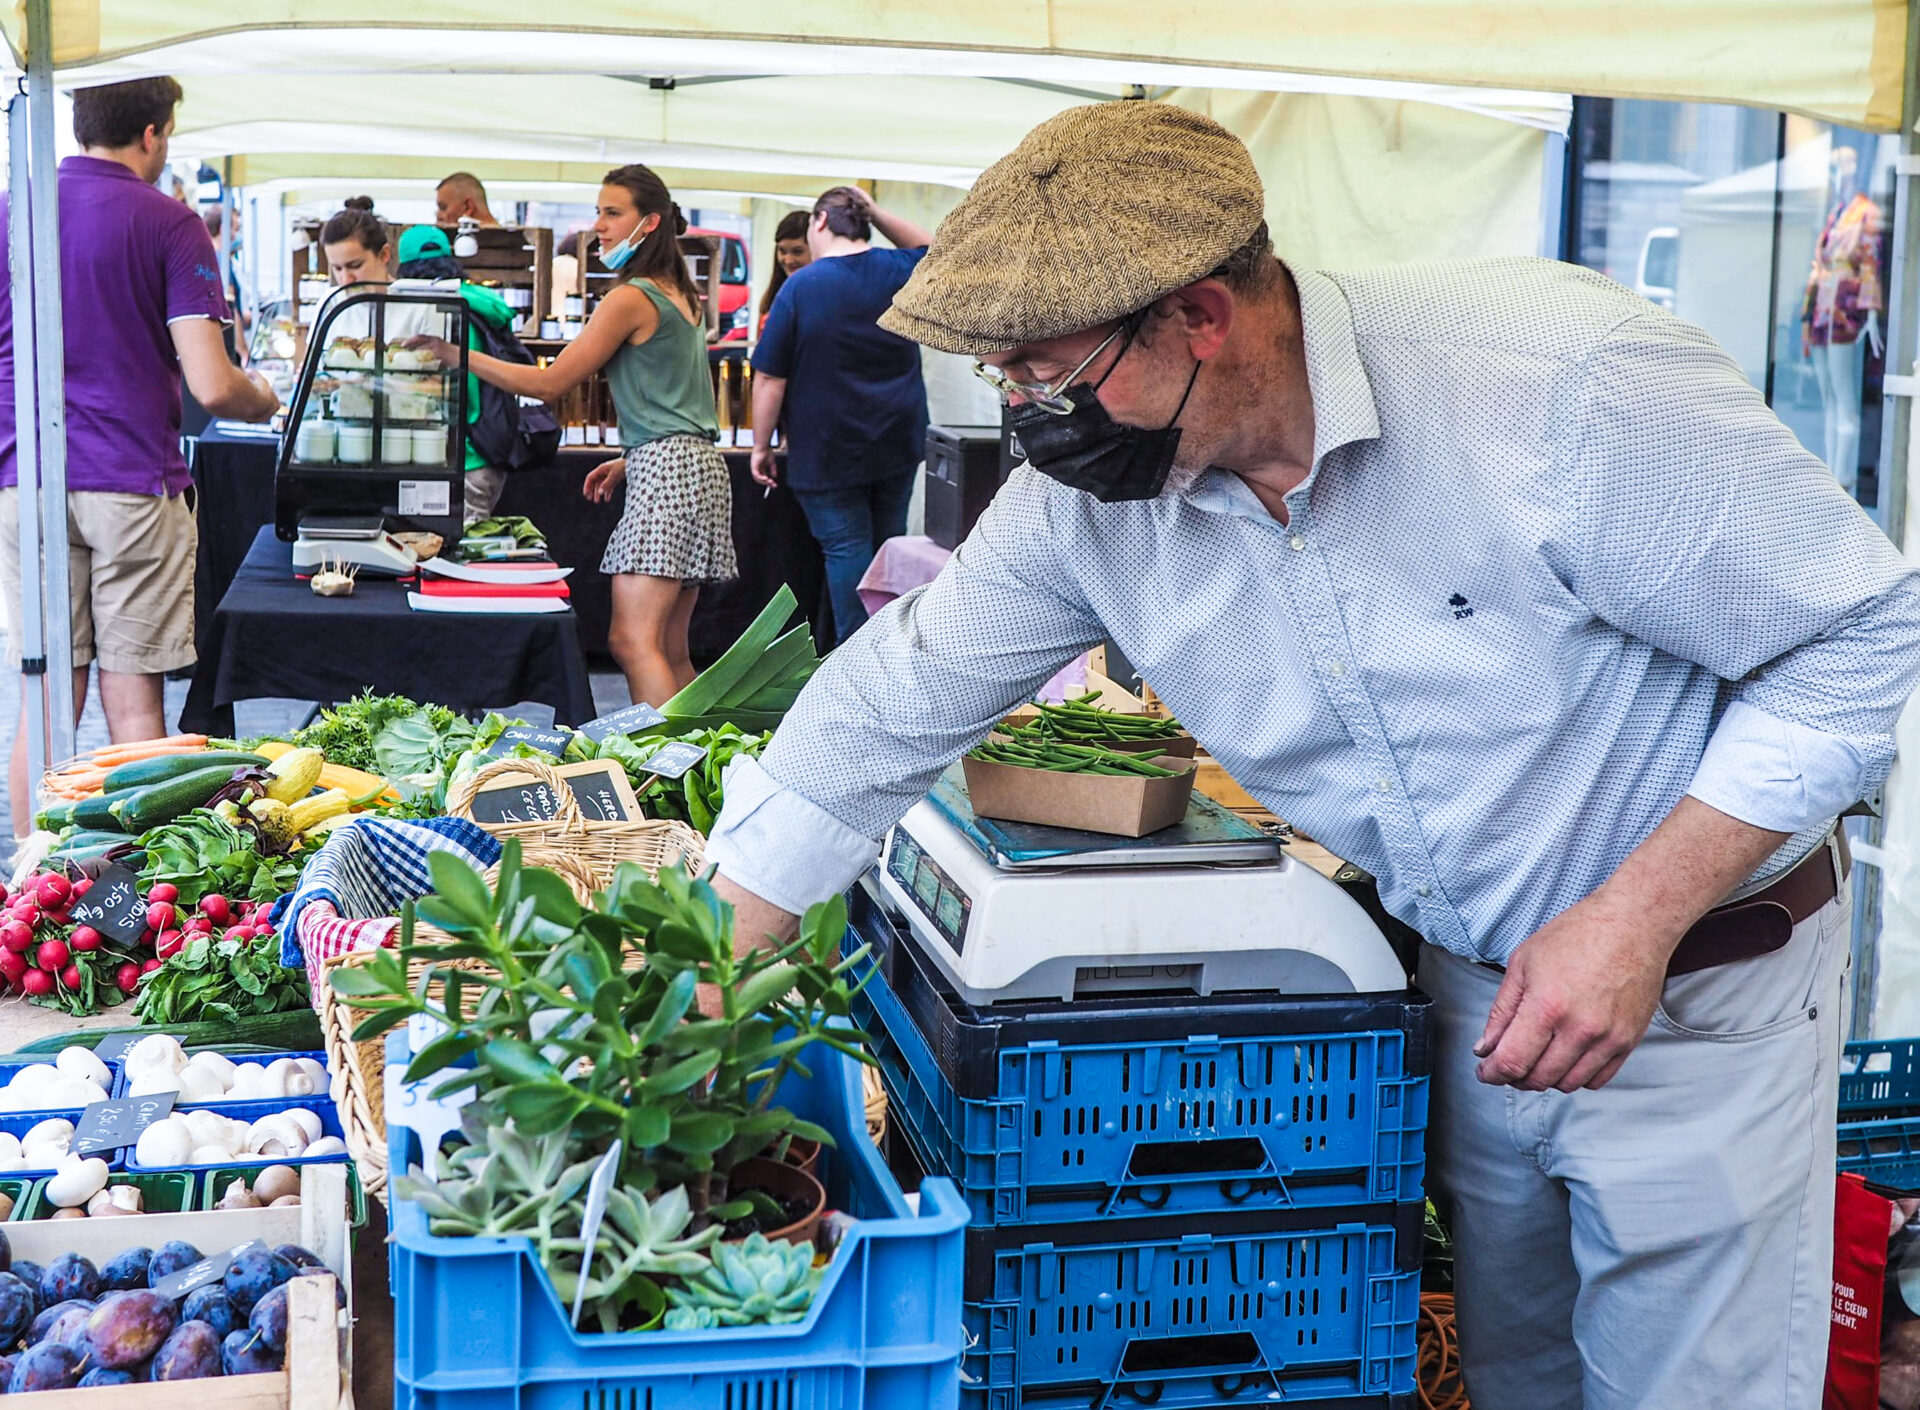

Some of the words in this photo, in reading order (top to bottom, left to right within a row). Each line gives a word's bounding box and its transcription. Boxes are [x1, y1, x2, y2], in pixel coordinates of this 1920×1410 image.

[104, 881, 130, 908] 1,50
[1835, 1282, 1855, 1300] POUR
[1834, 1296, 1844, 1310] LE
[1844, 1300, 1868, 1319] CŒUR
